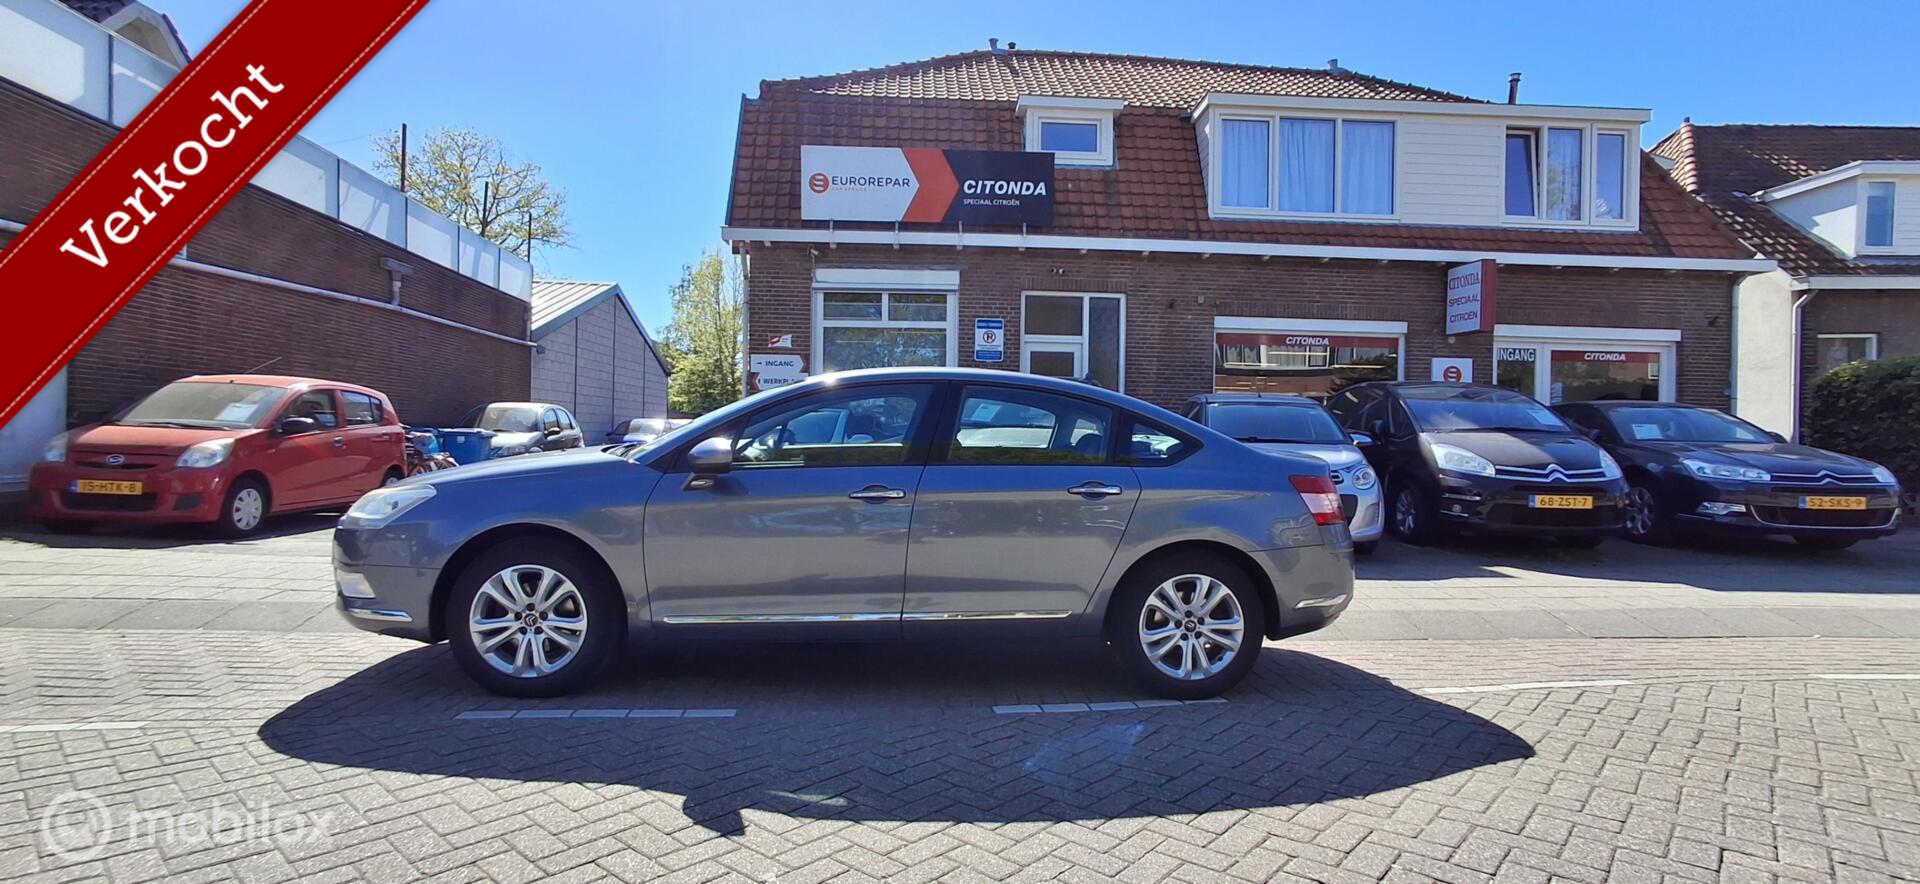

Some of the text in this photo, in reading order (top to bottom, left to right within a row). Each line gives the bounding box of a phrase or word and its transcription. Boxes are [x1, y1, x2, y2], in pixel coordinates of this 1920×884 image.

[831, 175, 910, 187] EUROREPAR
[963, 180, 1047, 195] CITONDA
[992, 198, 1020, 206] CITROËN
[1449, 272, 1480, 290] CITONDA
[1448, 294, 1479, 307] SPECIAAL
[1286, 336, 1330, 346] CITONDA
[1497, 348, 1535, 361] INGANG
[1584, 352, 1626, 361] CITONDA
[80, 481, 137, 493] 15-HTK-8
[1540, 496, 1588, 507] 68-ZST-7
[1808, 497, 1863, 508] 52-SKS-9
